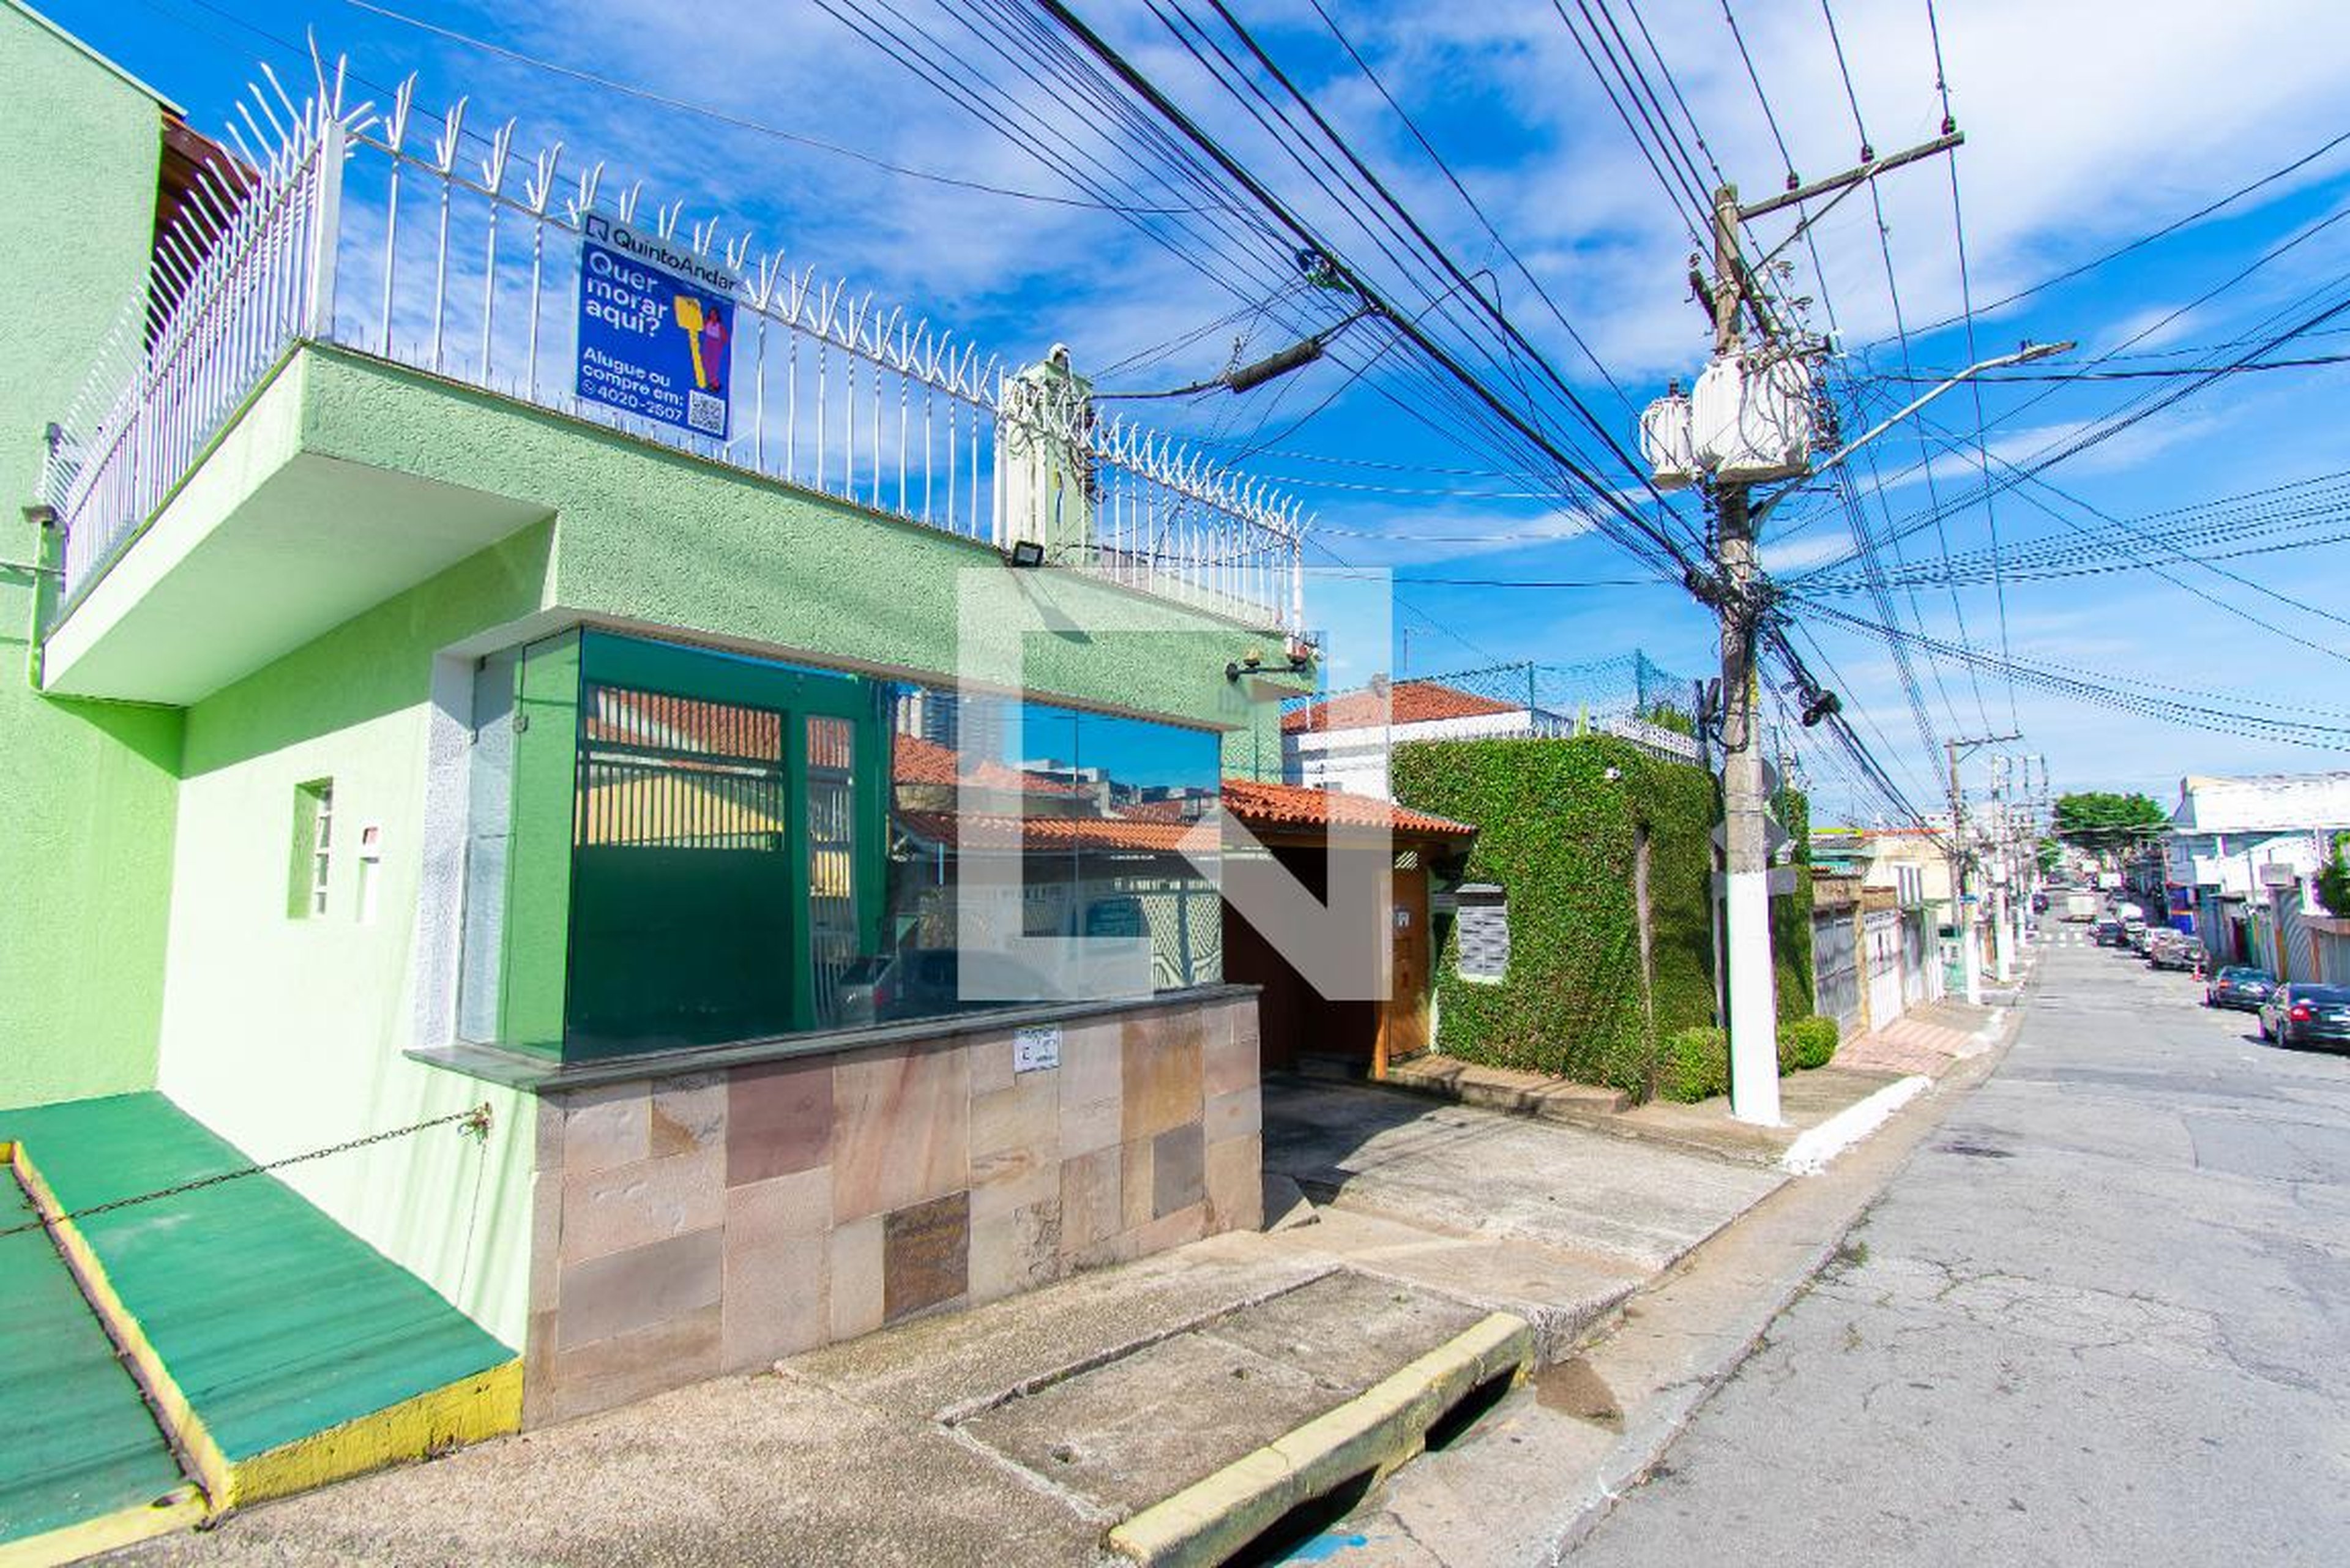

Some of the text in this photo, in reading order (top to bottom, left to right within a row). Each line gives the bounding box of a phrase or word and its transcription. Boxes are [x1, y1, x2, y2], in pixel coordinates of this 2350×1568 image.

[589, 252, 658, 292] Quer
[613, 229, 736, 291] QuintoAndar
[588, 277, 668, 318] morar
[586, 299, 660, 337] aqui?
[583, 365, 683, 406] compre em:
[584, 347, 670, 387] Alugue ou
